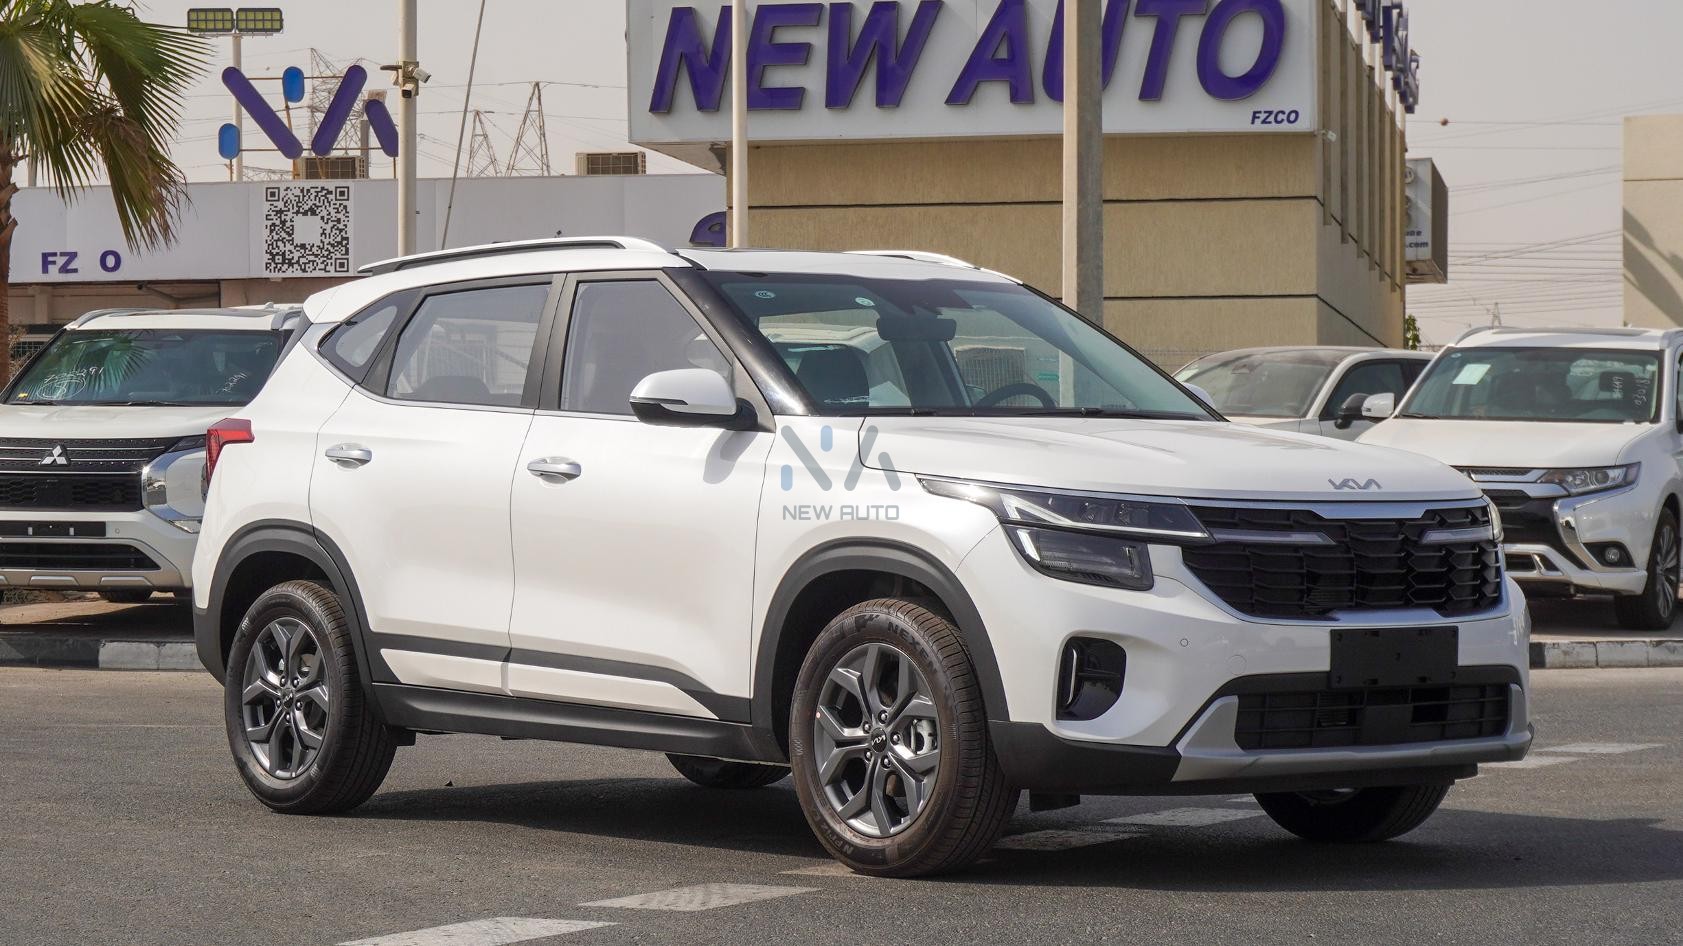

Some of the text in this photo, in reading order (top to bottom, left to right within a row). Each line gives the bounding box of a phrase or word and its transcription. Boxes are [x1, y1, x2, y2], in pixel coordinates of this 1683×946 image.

[649, 0, 945, 113] NEW
[944, 0, 1287, 106] AUTO
[1250, 109, 1300, 125] FZCO
